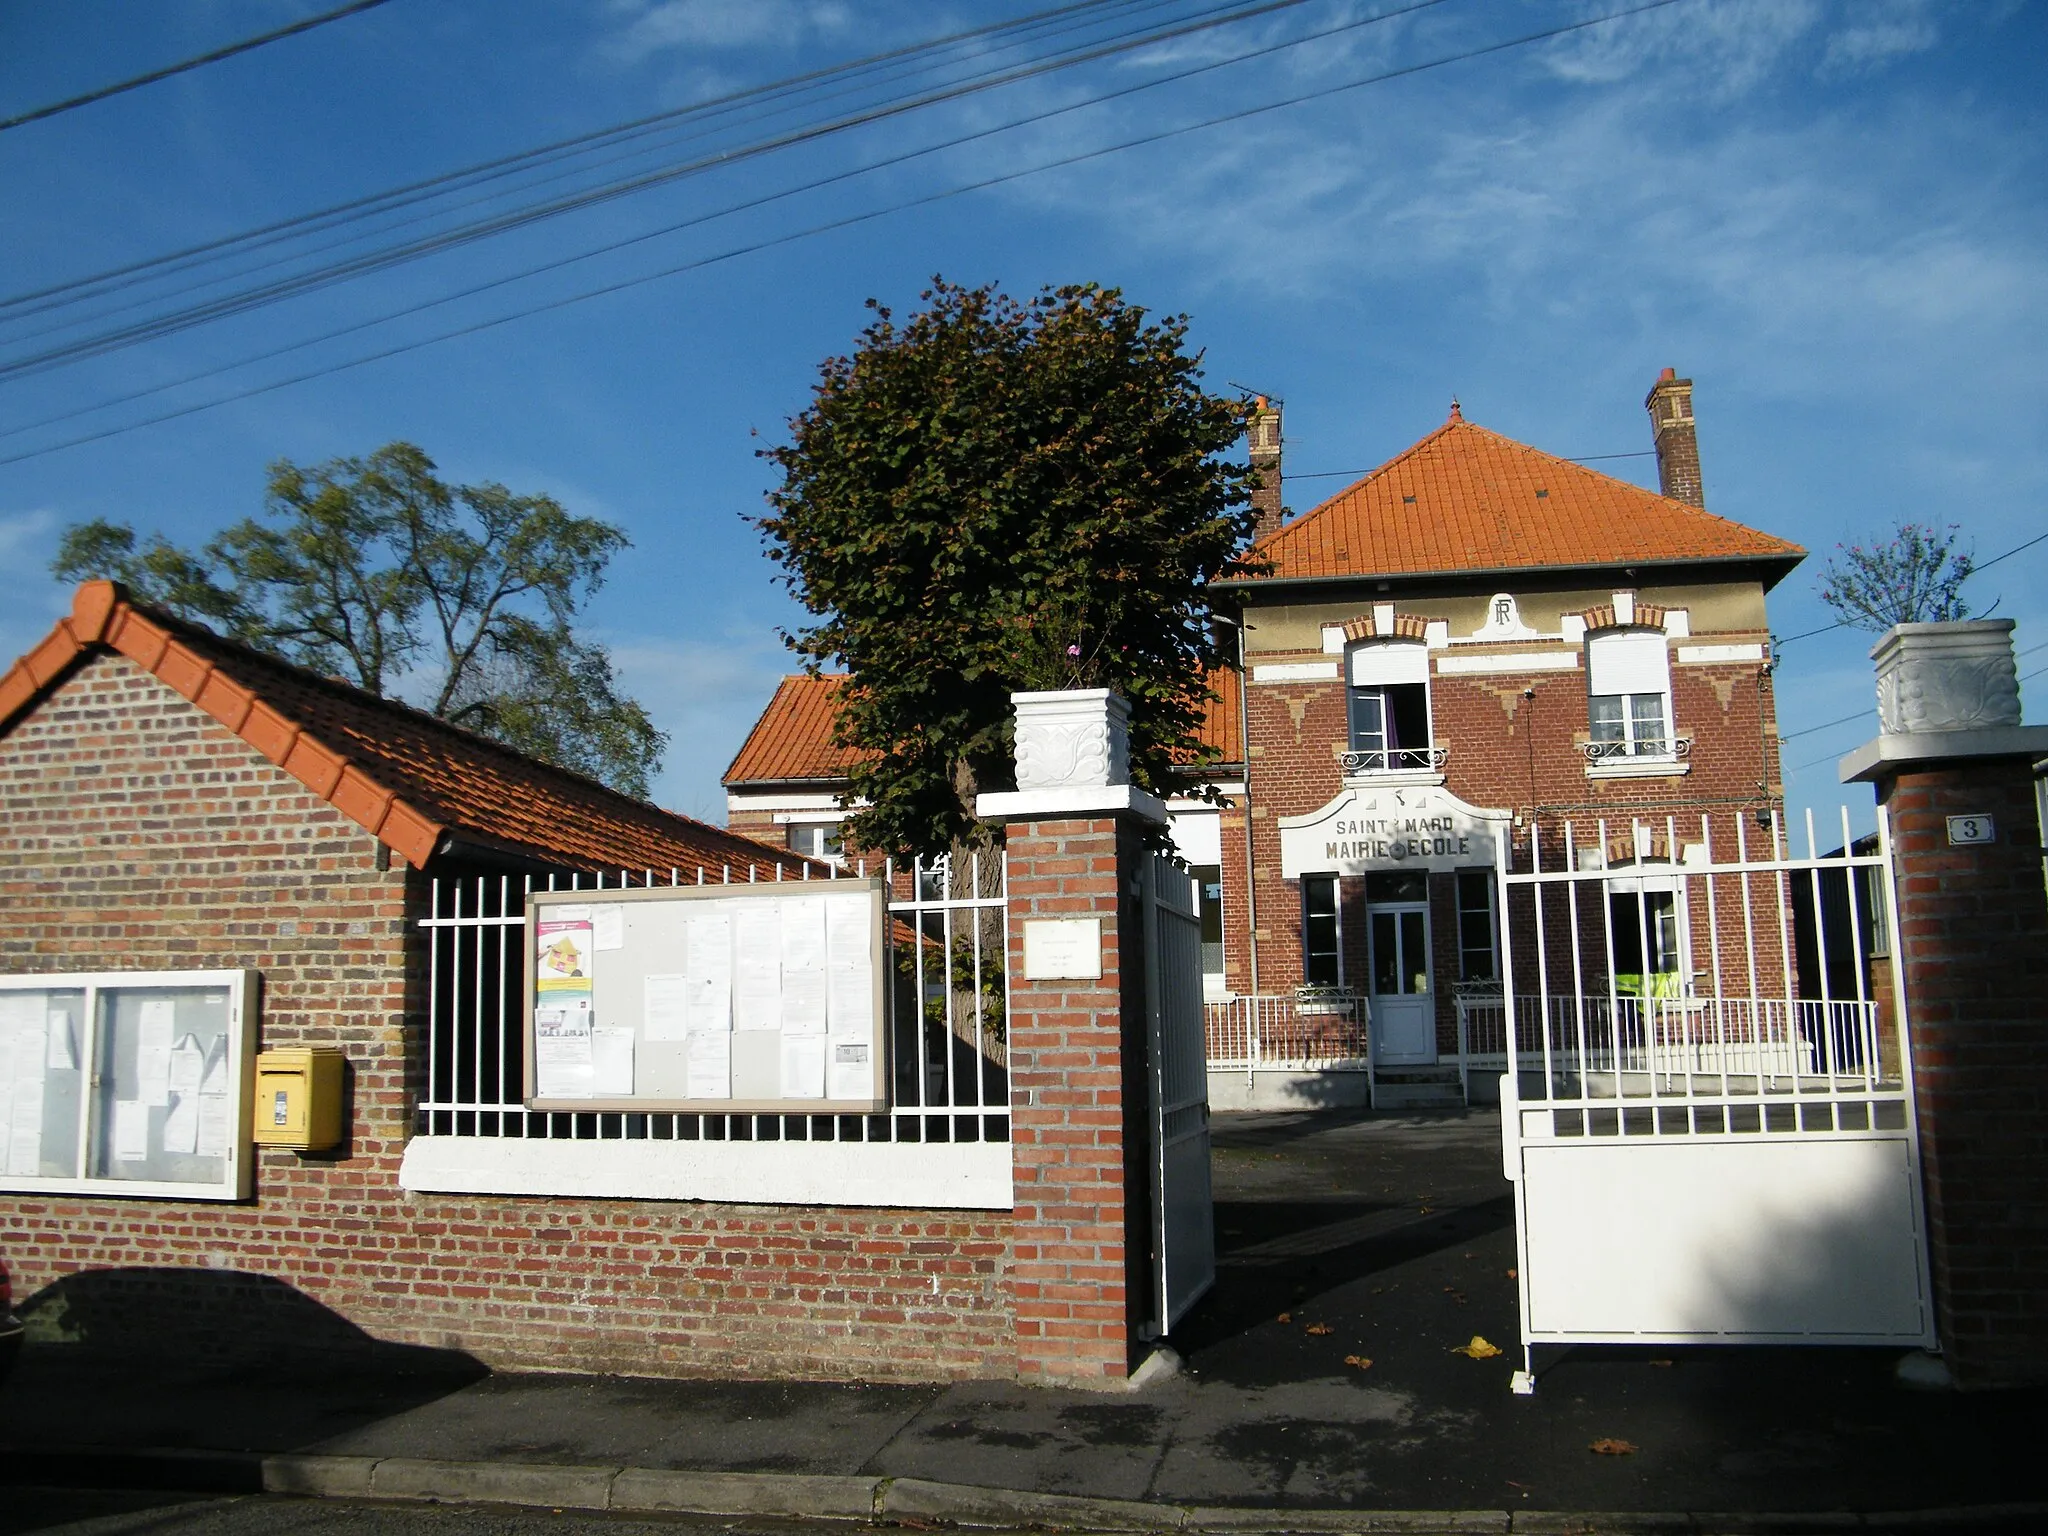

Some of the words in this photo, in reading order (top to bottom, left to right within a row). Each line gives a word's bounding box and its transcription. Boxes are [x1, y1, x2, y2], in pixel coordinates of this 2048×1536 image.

[1336, 819, 1388, 835] SAINT
[1405, 817, 1454, 833] MARD
[1963, 820, 1978, 838] 3
[1326, 840, 1389, 860] MAIRIE
[1407, 838, 1470, 857] ECOLE
